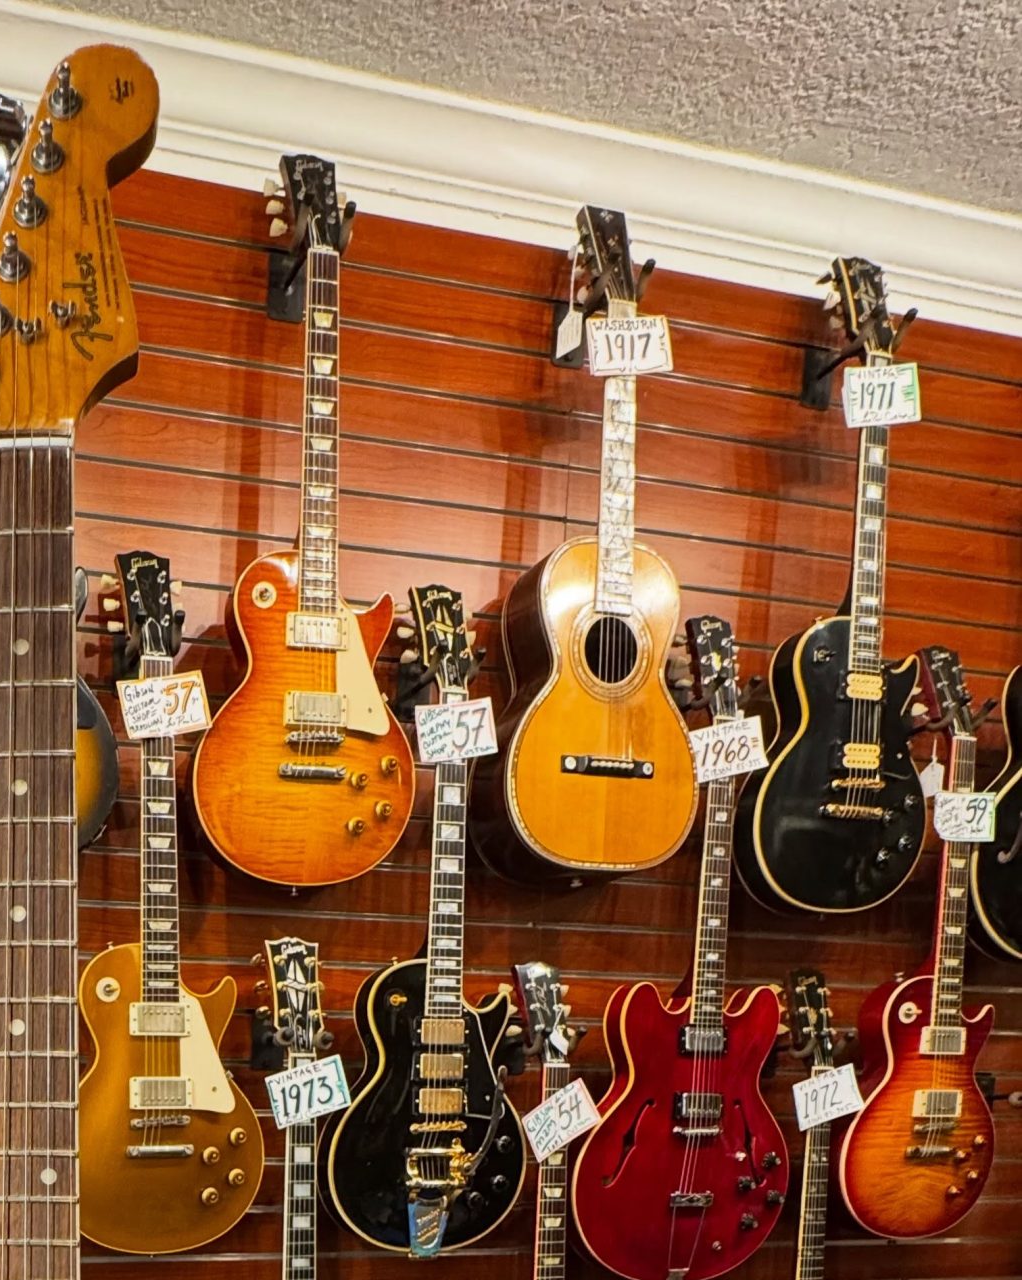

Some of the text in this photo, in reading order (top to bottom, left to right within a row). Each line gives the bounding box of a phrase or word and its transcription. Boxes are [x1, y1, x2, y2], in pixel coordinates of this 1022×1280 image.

[62, 252, 114, 361] Fender
[592, 318, 658, 333] WASHBURN
[604, 332, 652, 364] 1917
[859, 380, 896, 412] 1971
[693, 720, 752, 742] VINTAGE
[701, 735, 751, 768] 1968
[275, 1063, 323, 1086] VINTAGE
[279, 1075, 335, 1118] 1973
[558, 1091, 584, 1132] 54
[802, 1080, 843, 1120] 1972
